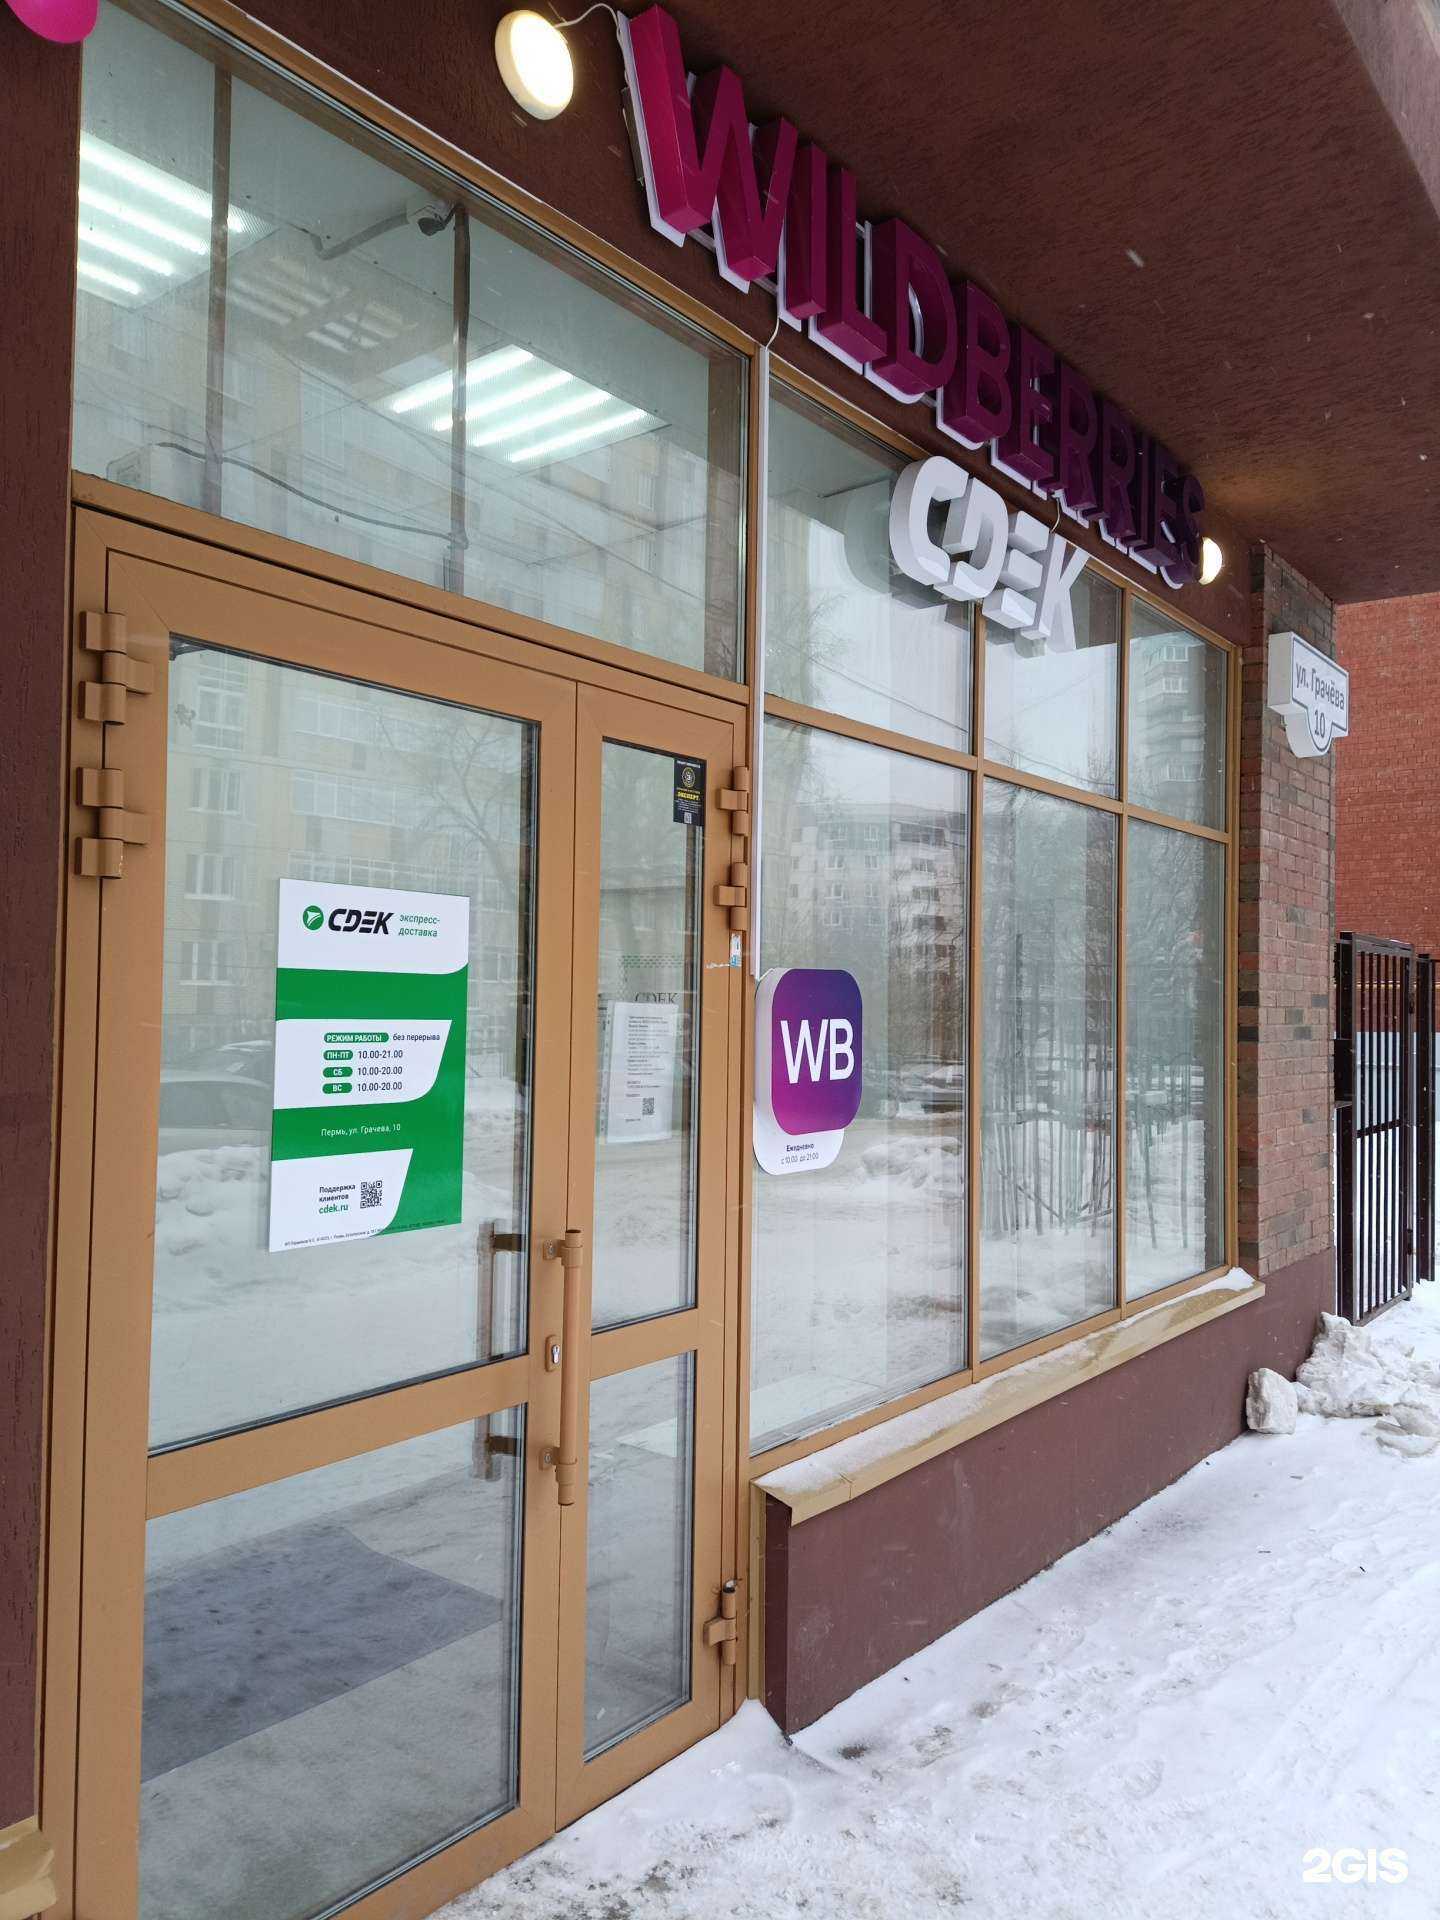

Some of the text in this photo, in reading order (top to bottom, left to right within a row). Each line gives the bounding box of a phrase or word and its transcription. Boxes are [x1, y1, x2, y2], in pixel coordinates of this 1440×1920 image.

[616, 3, 1206, 590] WILDBERRIES
[889, 455, 1092, 652] CDEK
[1295, 663, 1345, 710] ул. Грачёва
[1314, 708, 1326, 738] 10
[328, 908, 394, 935] CDEK
[399, 914, 440, 925] экспресс-
[398, 927, 438, 937] доставка
[326, 1033, 441, 1042] РЕЖИМ РАБОТЫ без перерыва
[327, 1050, 404, 1060] ПН-ПТ 10.00-21.00
[780, 1018, 855, 1084] WB
[333, 1066, 403, 1076] СБ 10.00-20.00
[332, 1082, 403, 1092] ВС 10.00-20.00
[392, 1123, 401, 1131] 10
[786, 1144, 815, 1152] Ежедневно
[319, 1184, 356, 1193] Поддержка
[319, 1194, 349, 1202] клиентов
[318, 1204, 349, 1214] cdek.ru
